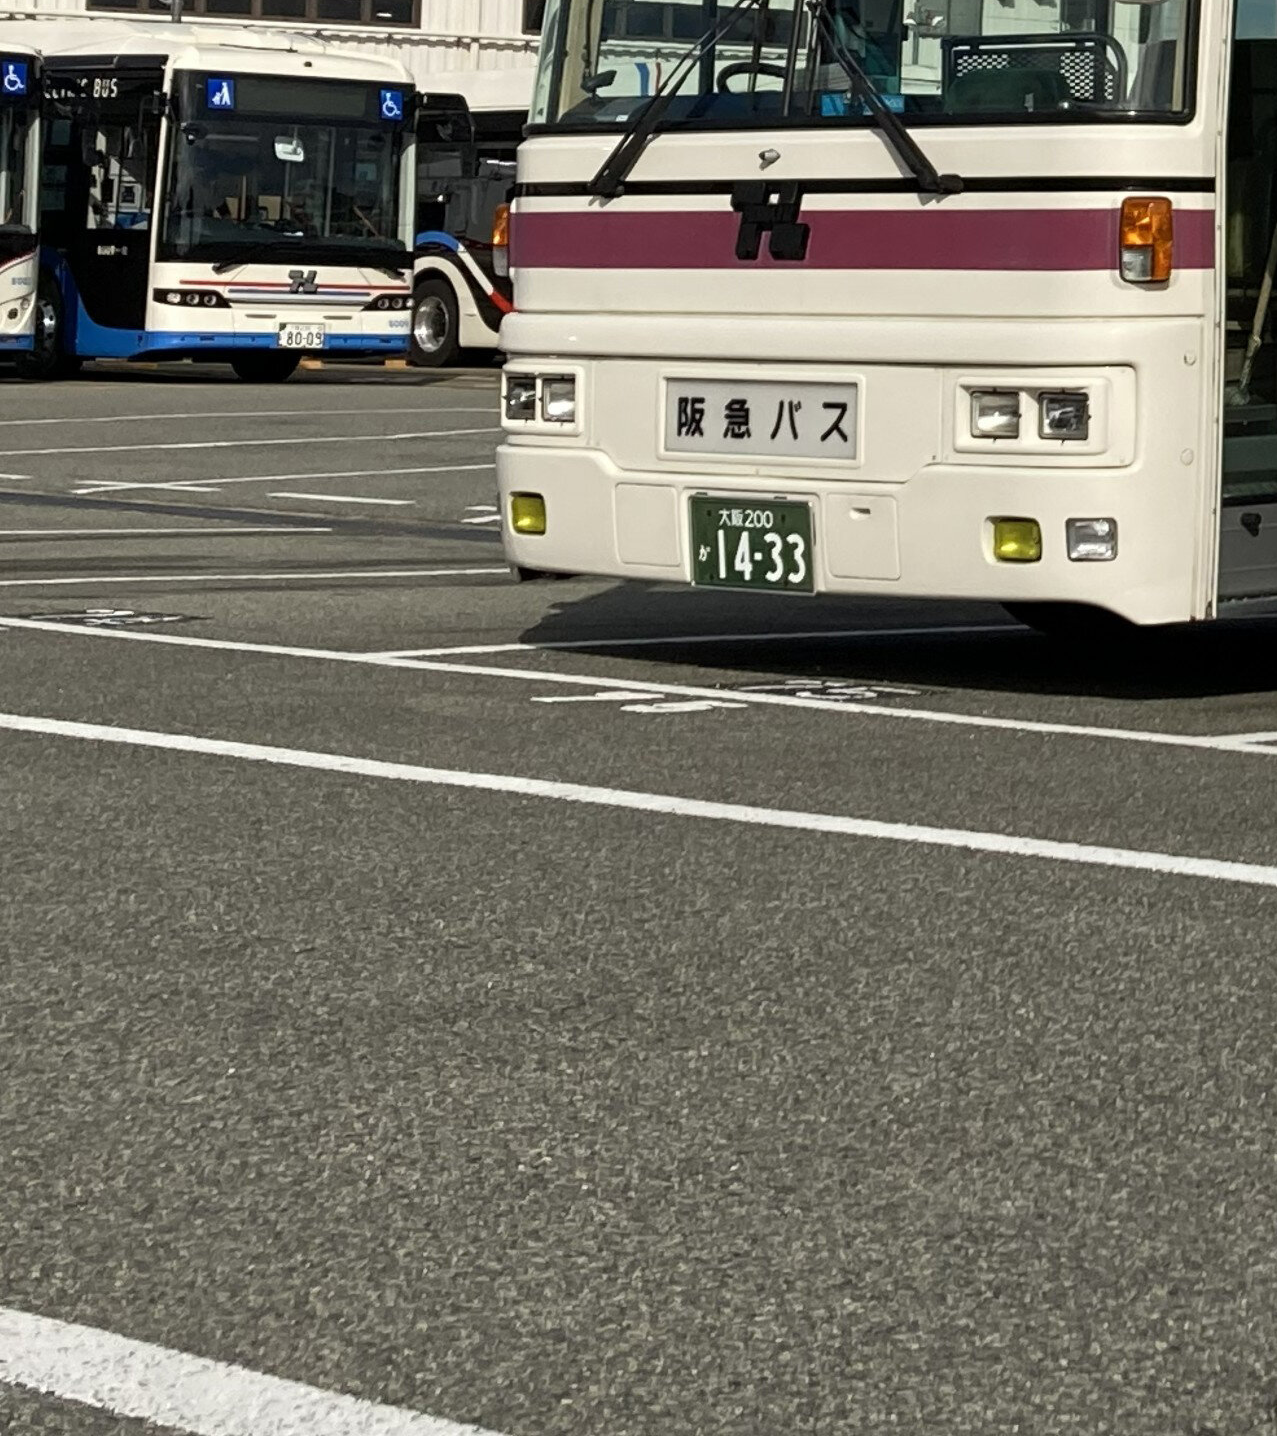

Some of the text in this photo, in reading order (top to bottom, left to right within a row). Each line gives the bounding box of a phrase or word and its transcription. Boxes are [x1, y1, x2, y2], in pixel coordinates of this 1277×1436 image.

[286, 330, 322, 346] 80-09
[676, 396, 849, 443] 阪急バス
[718, 507, 774, 529] 大阪200
[716, 528, 807, 584] 14-33
